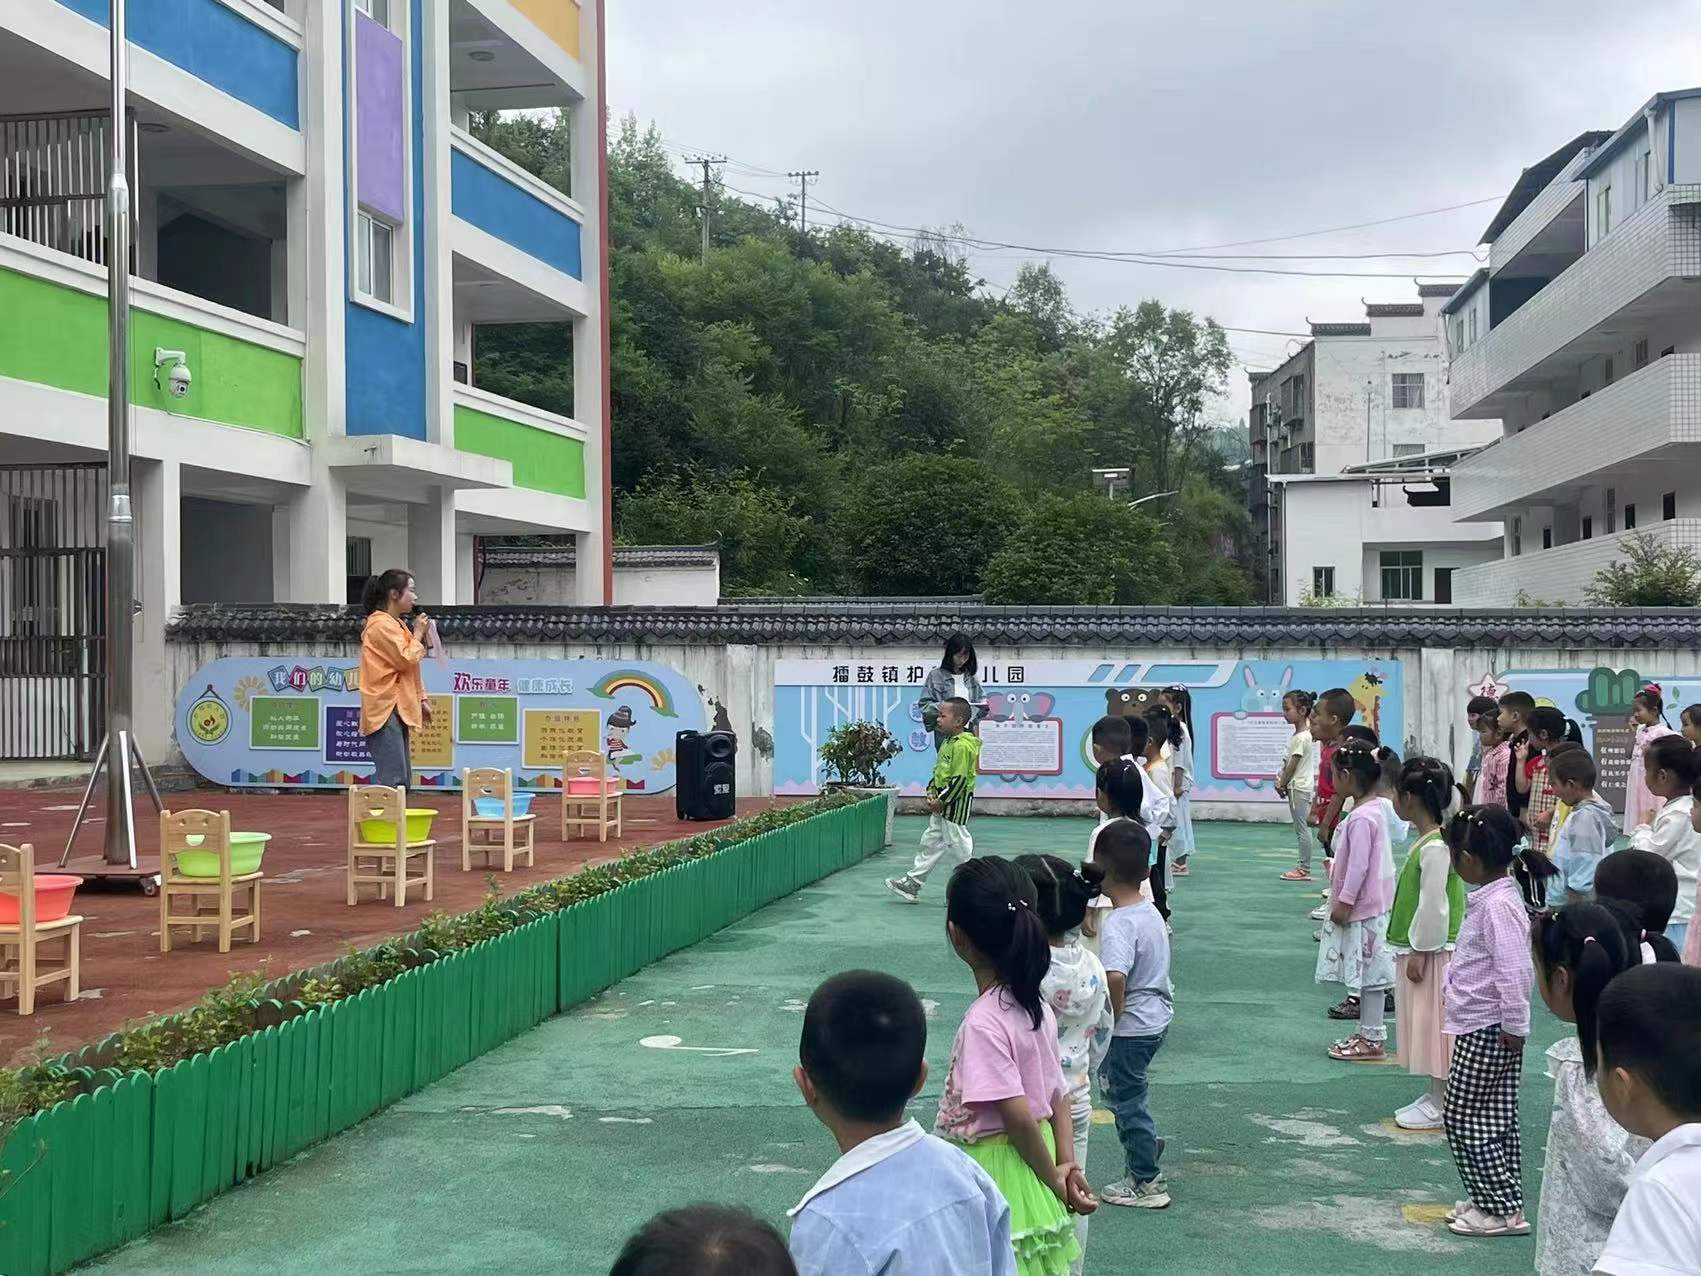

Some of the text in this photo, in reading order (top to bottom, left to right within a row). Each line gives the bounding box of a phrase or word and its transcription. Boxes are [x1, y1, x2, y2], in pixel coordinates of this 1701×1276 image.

[453, 672, 574, 694] 欢乐童年 健康成长
[832, 665, 1025, 684] 擂鼓镇护儿园
